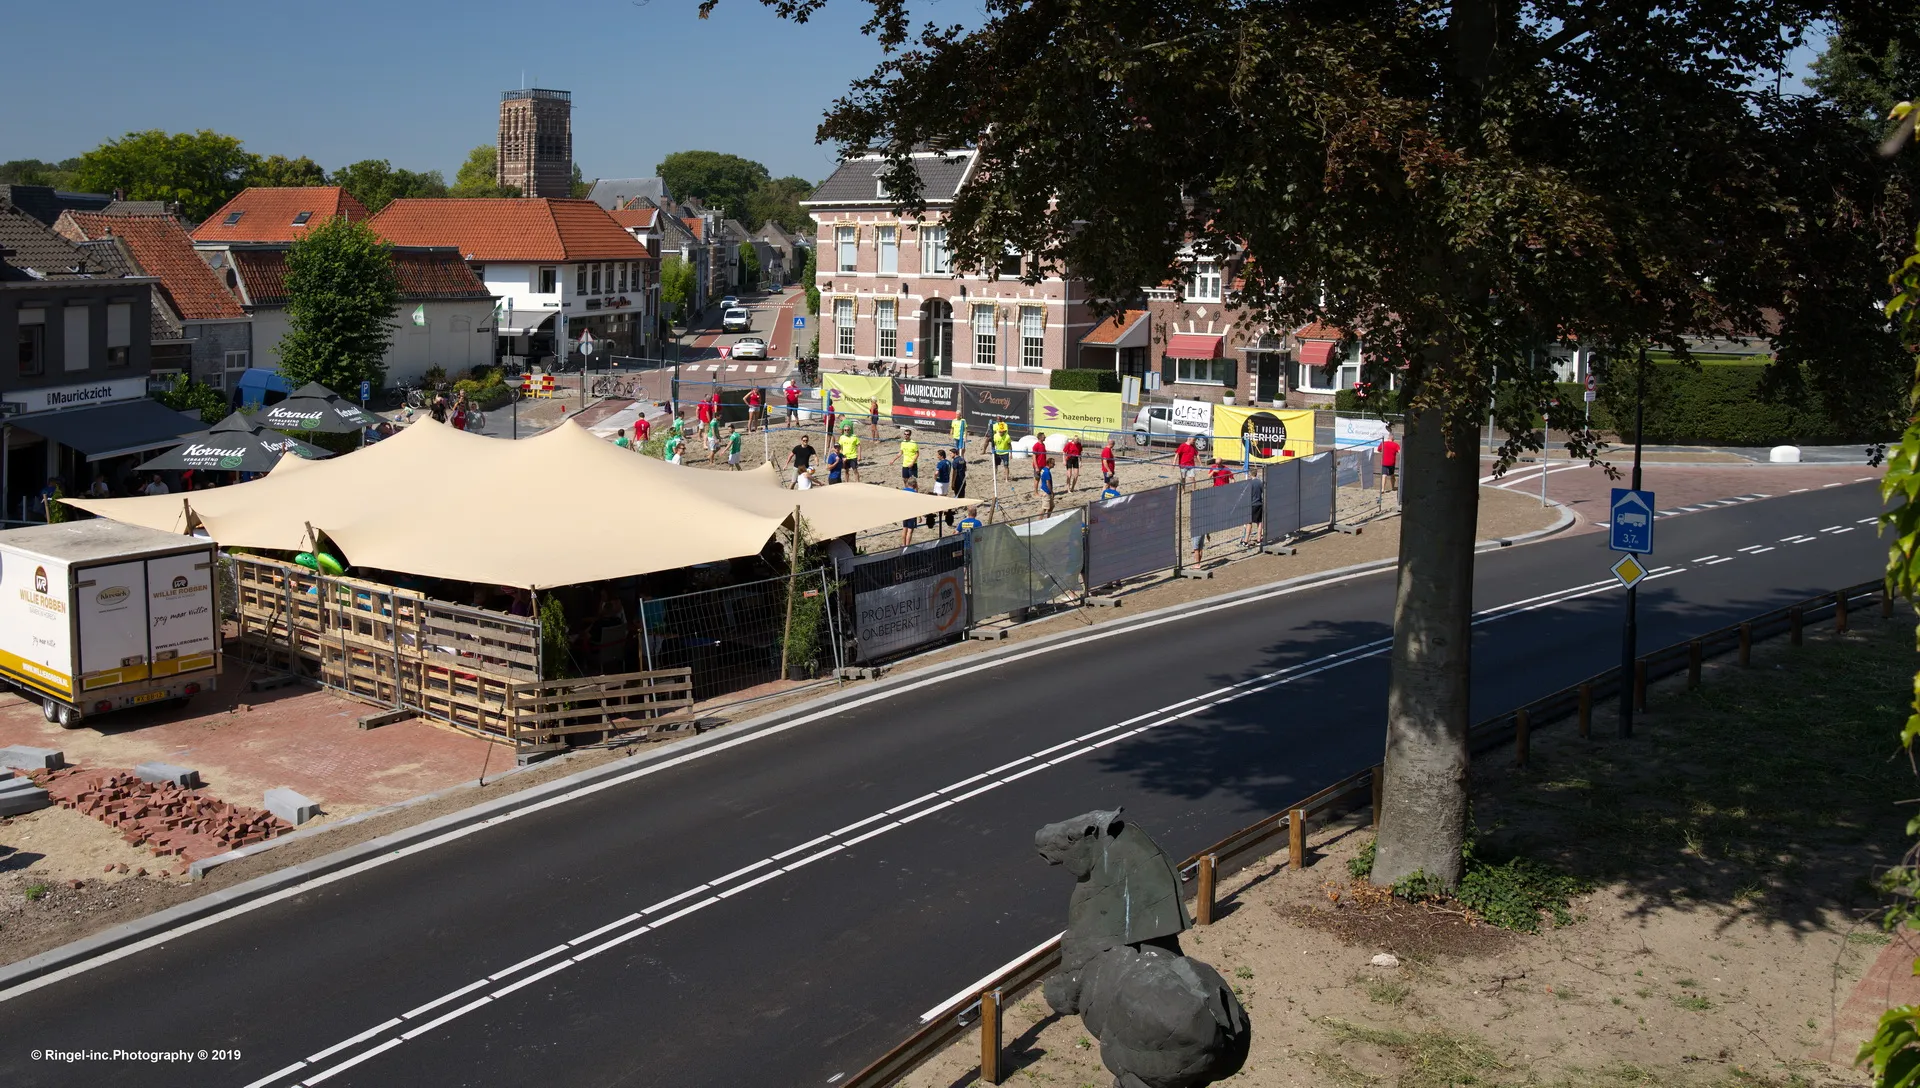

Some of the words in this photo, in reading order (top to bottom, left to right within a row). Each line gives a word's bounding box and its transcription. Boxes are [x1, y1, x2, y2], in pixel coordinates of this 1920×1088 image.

[52, 386, 112, 405] Maurickzicht
[904, 384, 953, 399] MAURICKZICHT
[267, 407, 323, 419] Kornuit
[1062, 412, 1102, 424] hazenberg
[182, 444, 246, 457] Kornuit
[153, 588, 178, 599] WILLIE
[178, 584, 208, 595] ROBBEN
[20, 588, 40, 606] WILLIE
[40, 594, 66, 614] ROBBEN
[861, 597, 921, 624] PROEVERIJ
[862, 615, 920, 641] ONBEPERKT
